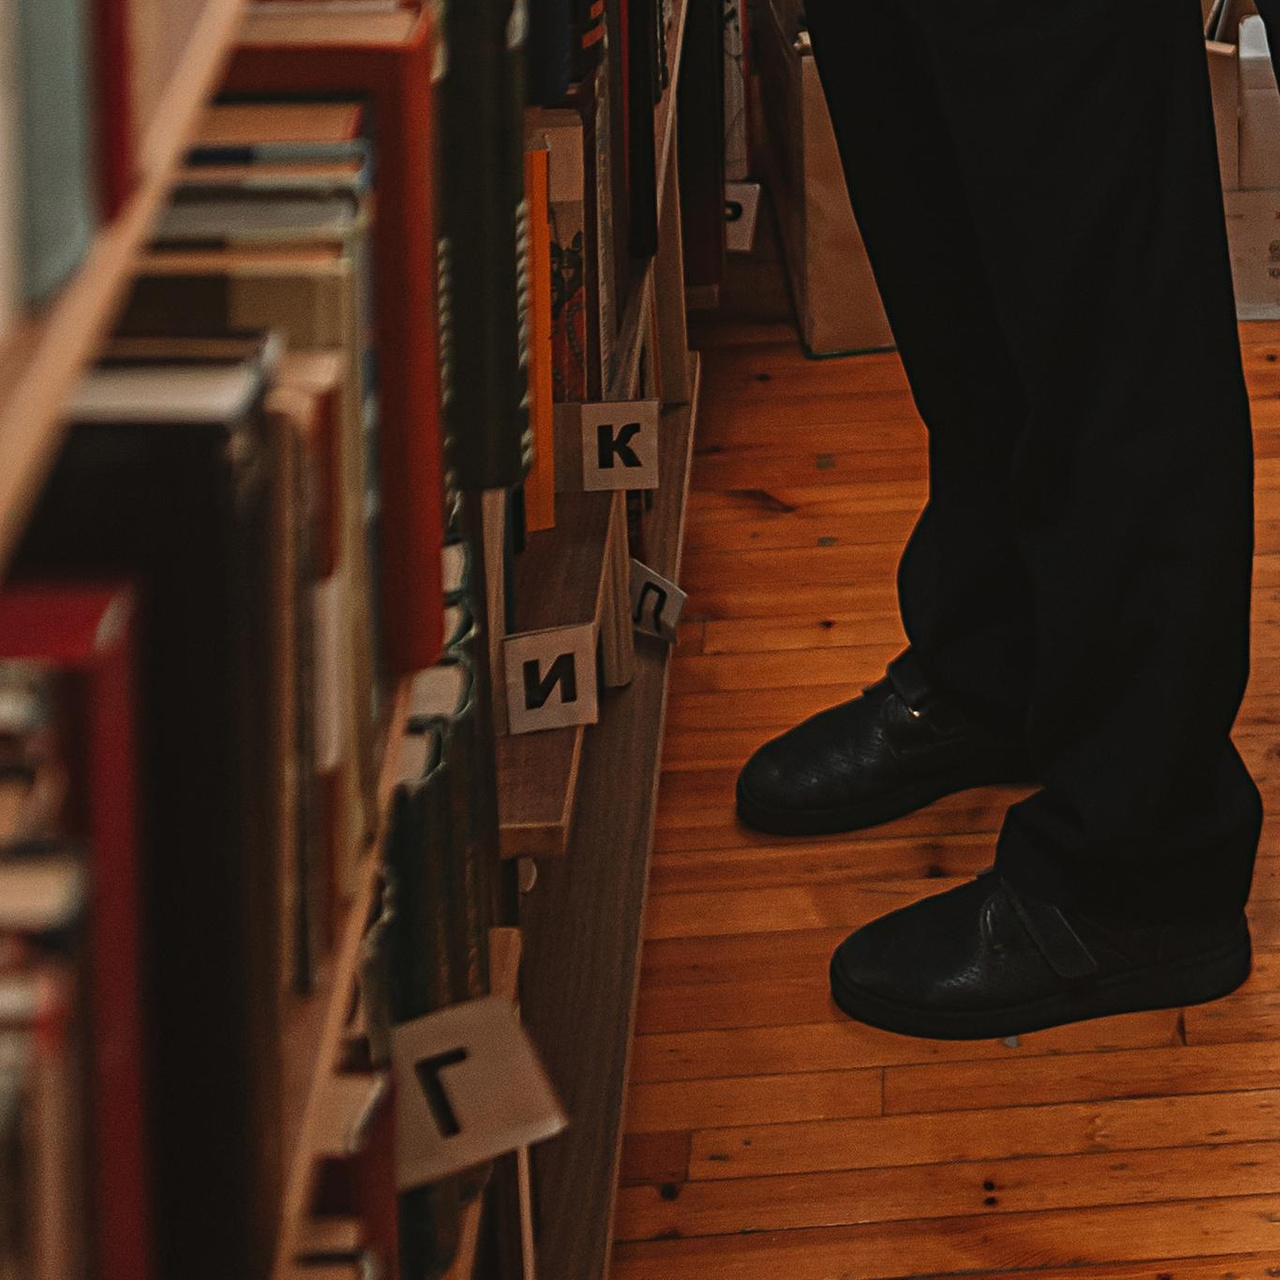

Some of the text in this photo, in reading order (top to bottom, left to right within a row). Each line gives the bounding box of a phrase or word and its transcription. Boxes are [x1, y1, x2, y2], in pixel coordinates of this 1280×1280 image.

[596, 423, 642, 469] К
[522, 652, 579, 710] И
[415, 1046, 468, 1138] Г
